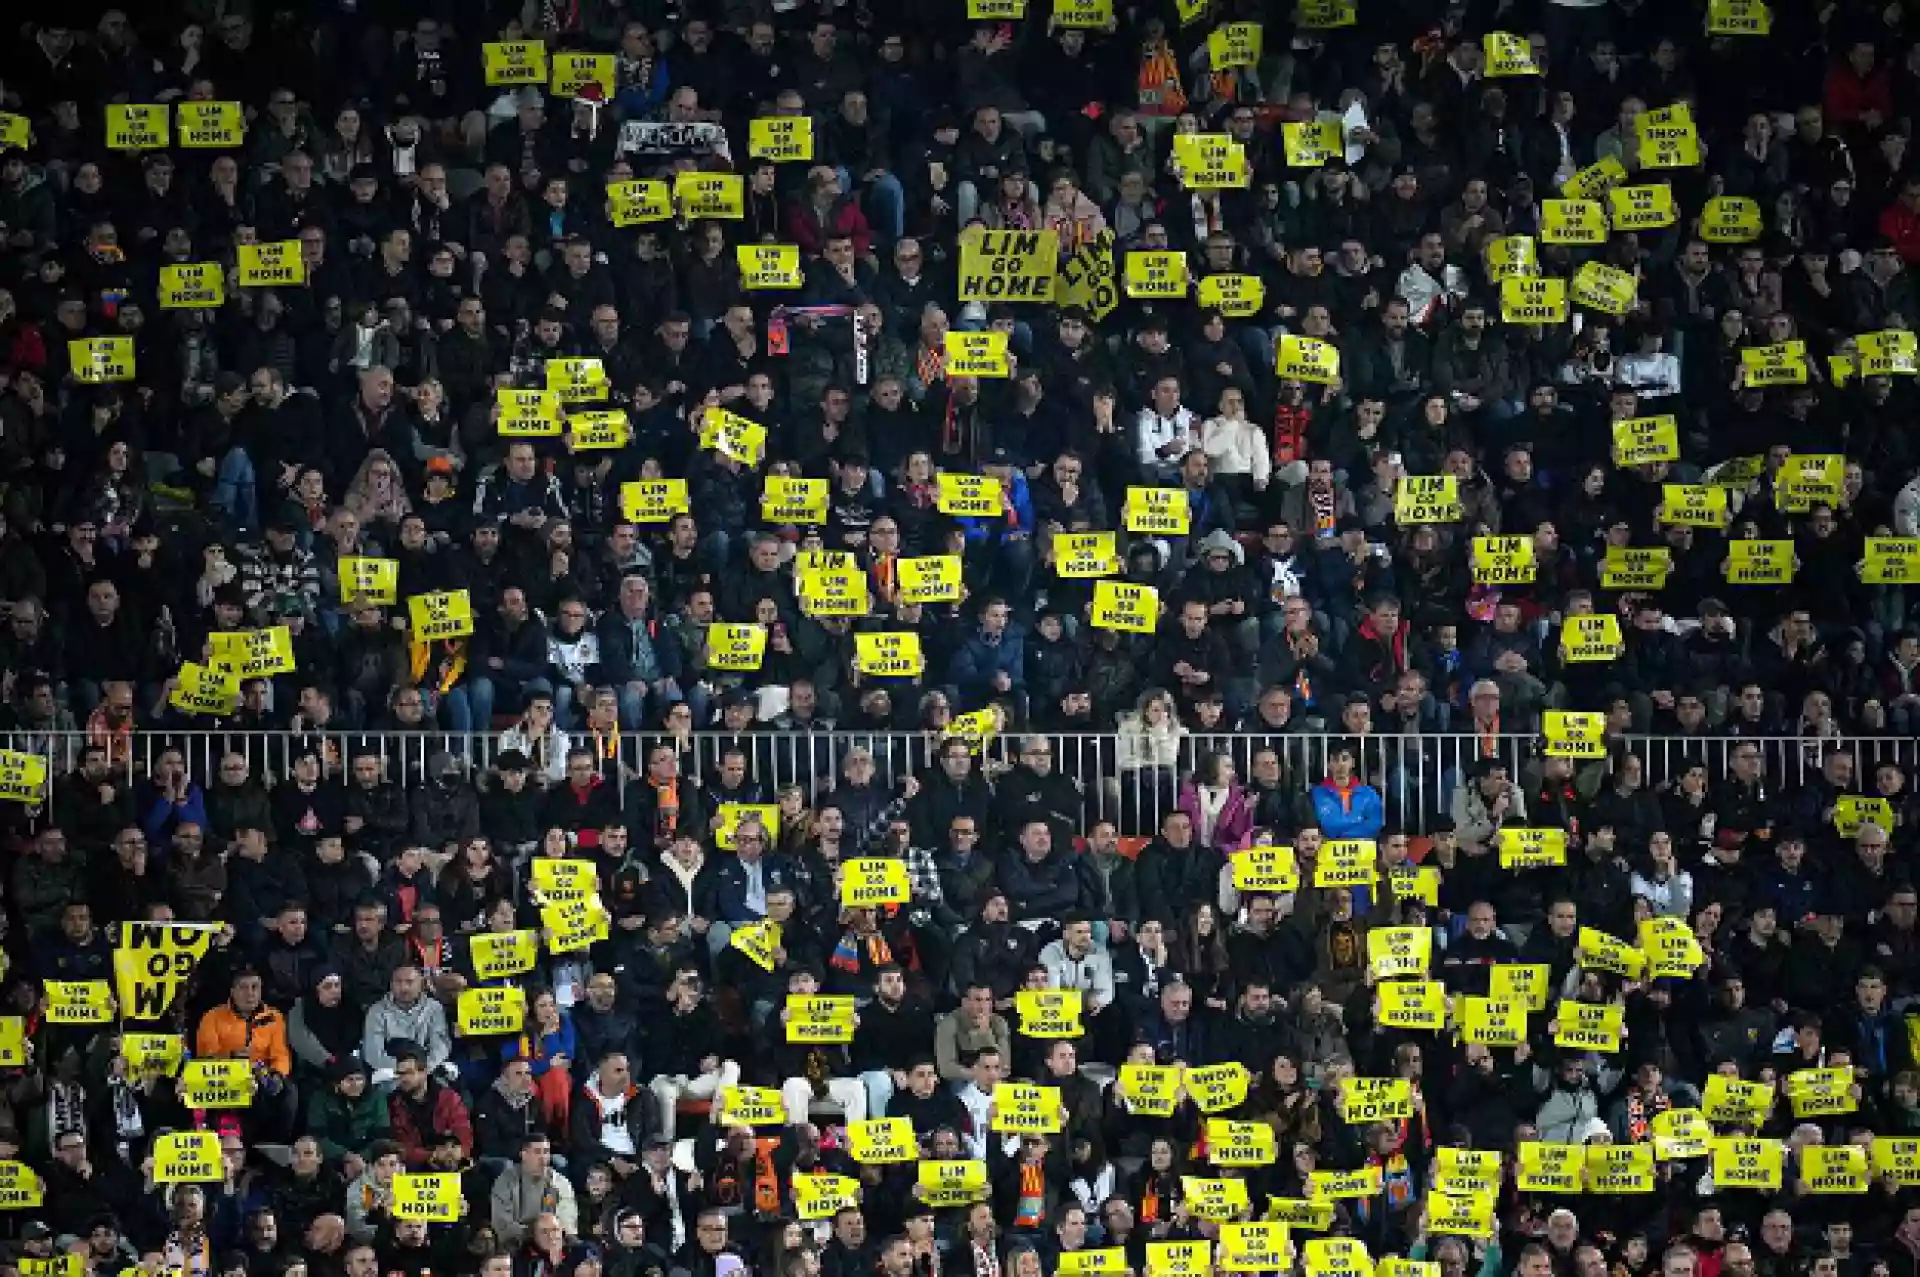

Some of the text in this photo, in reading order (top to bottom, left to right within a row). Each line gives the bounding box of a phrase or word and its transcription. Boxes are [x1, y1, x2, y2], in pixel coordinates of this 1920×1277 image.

[980, 233, 1038, 255] LIM
[992, 258, 1023, 273] GO
[964, 276, 1051, 296] HOME
[1348, 1100, 1410, 1120] HOME
